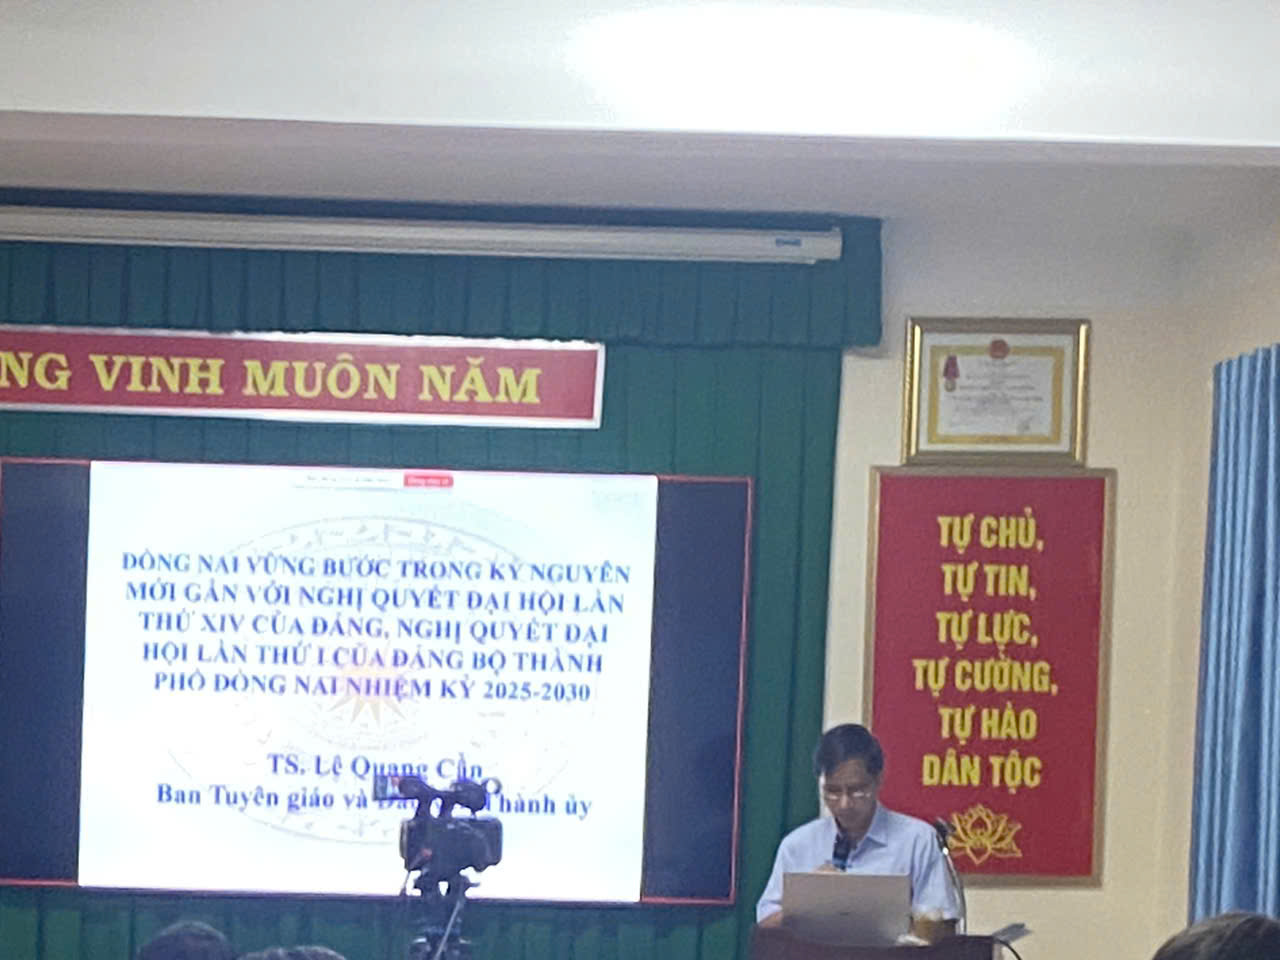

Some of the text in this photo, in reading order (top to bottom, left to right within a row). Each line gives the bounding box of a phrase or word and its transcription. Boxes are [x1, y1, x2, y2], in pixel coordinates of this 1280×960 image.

[89, 354, 224, 396] VINH
[243, 354, 399, 400] MUÔN
[420, 357, 542, 405] NĂM
[937, 507, 1045, 553] TỰ CHỦ,
[198, 555, 239, 575] NAI
[399, 560, 482, 580] TRONG
[530, 559, 631, 583] NGUYÊN
[941, 562, 1037, 602] TỰ TIN,
[300, 586, 363, 612] NGHỊ
[520, 590, 564, 615] HỘI
[201, 613, 245, 632] XIV
[398, 618, 461, 644] NGHỊ
[936, 610, 1039, 651] TỰ LỰC,
[144, 641, 188, 666] HỘI
[473, 650, 507, 676] BỘ
[513, 647, 602, 673] THÀNH
[913, 651, 1058, 697] TỰ CƯỜNG,
[294, 675, 337, 696] NAI
[346, 676, 431, 702] NHIỆM
[484, 680, 590, 702] 2025-2030
[938, 702, 1038, 745] TỰ HÀO
[267, 753, 305, 775] TS.
[351, 755, 428, 781] Quang
[922, 749, 1043, 793] DÂN TỘC
[157, 783, 200, 804] Ban
[209, 784, 279, 812] Tuyên
[287, 787, 334, 812] giáo
[344, 788, 368, 809] và
